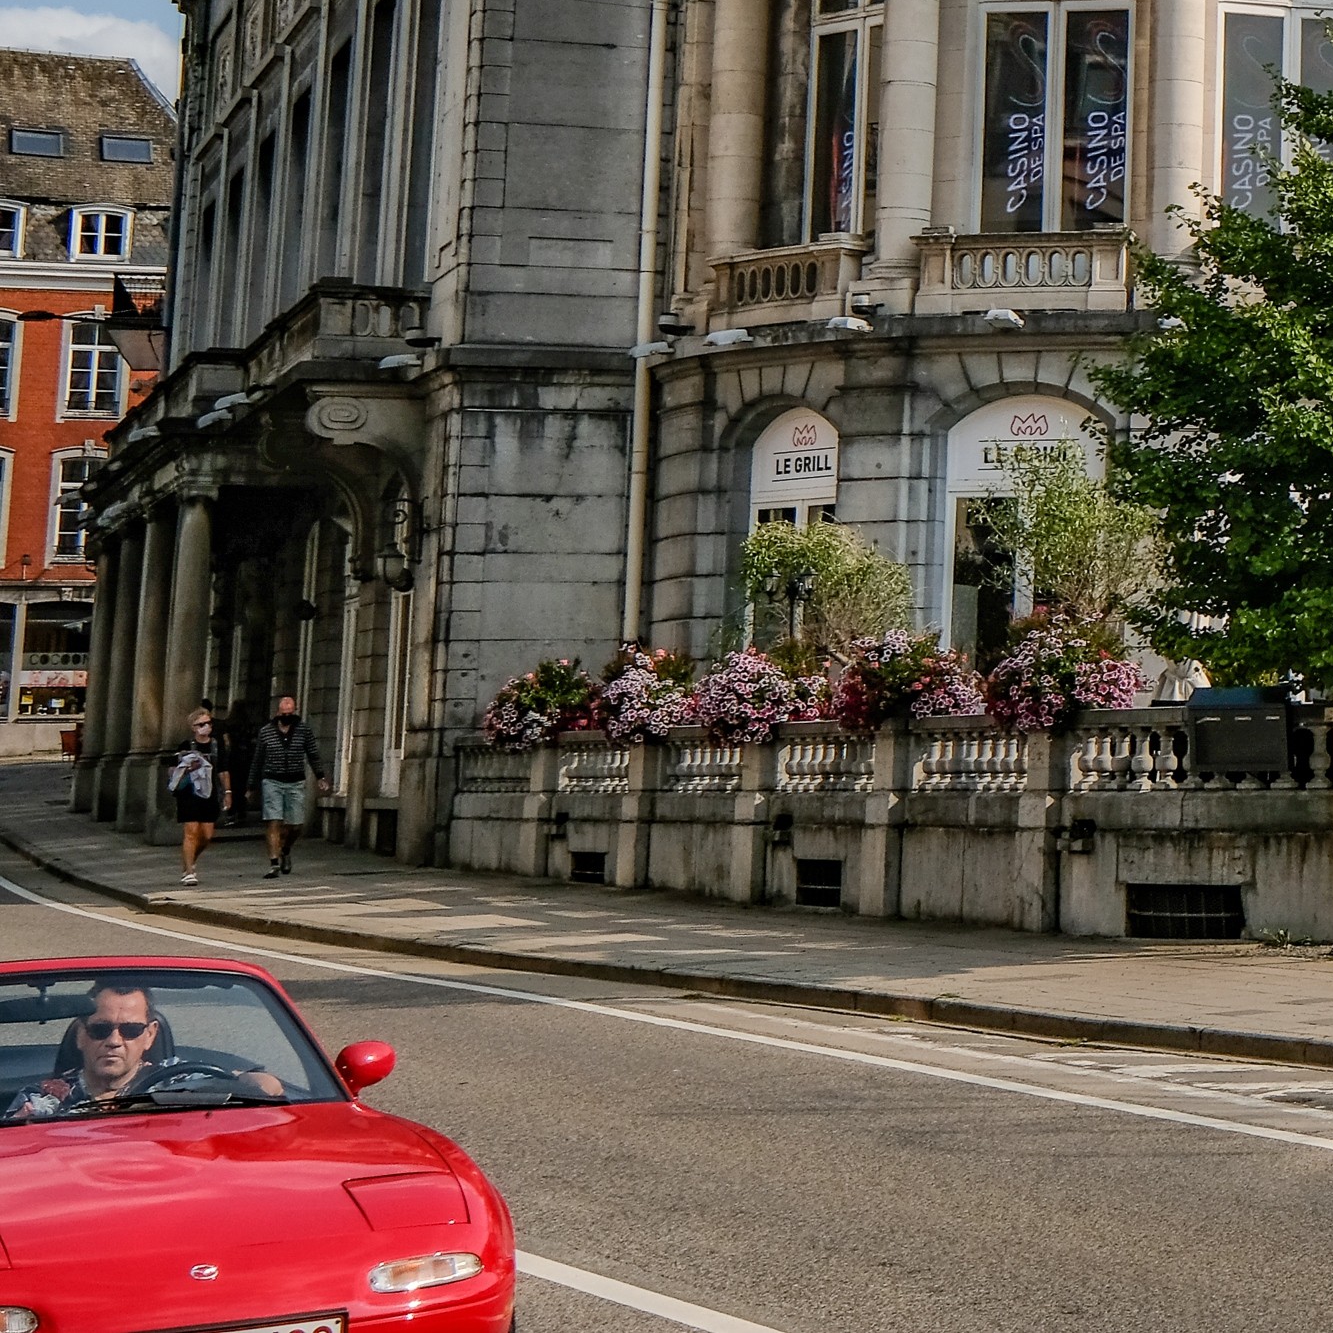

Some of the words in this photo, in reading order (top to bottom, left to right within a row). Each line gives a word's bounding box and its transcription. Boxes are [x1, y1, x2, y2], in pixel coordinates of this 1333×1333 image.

[1031, 114, 1044, 150] SPA
[1111, 111, 1125, 148] SPA
[1006, 113, 1029, 212] CASINO
[1030, 157, 1043, 182] DE
[1085, 111, 1108, 210] CASINO
[1110, 157, 1125, 182] DE
[1231, 115, 1254, 210] CASINO
[776, 458, 791, 475] LE
[794, 454, 832, 474] GRILL
